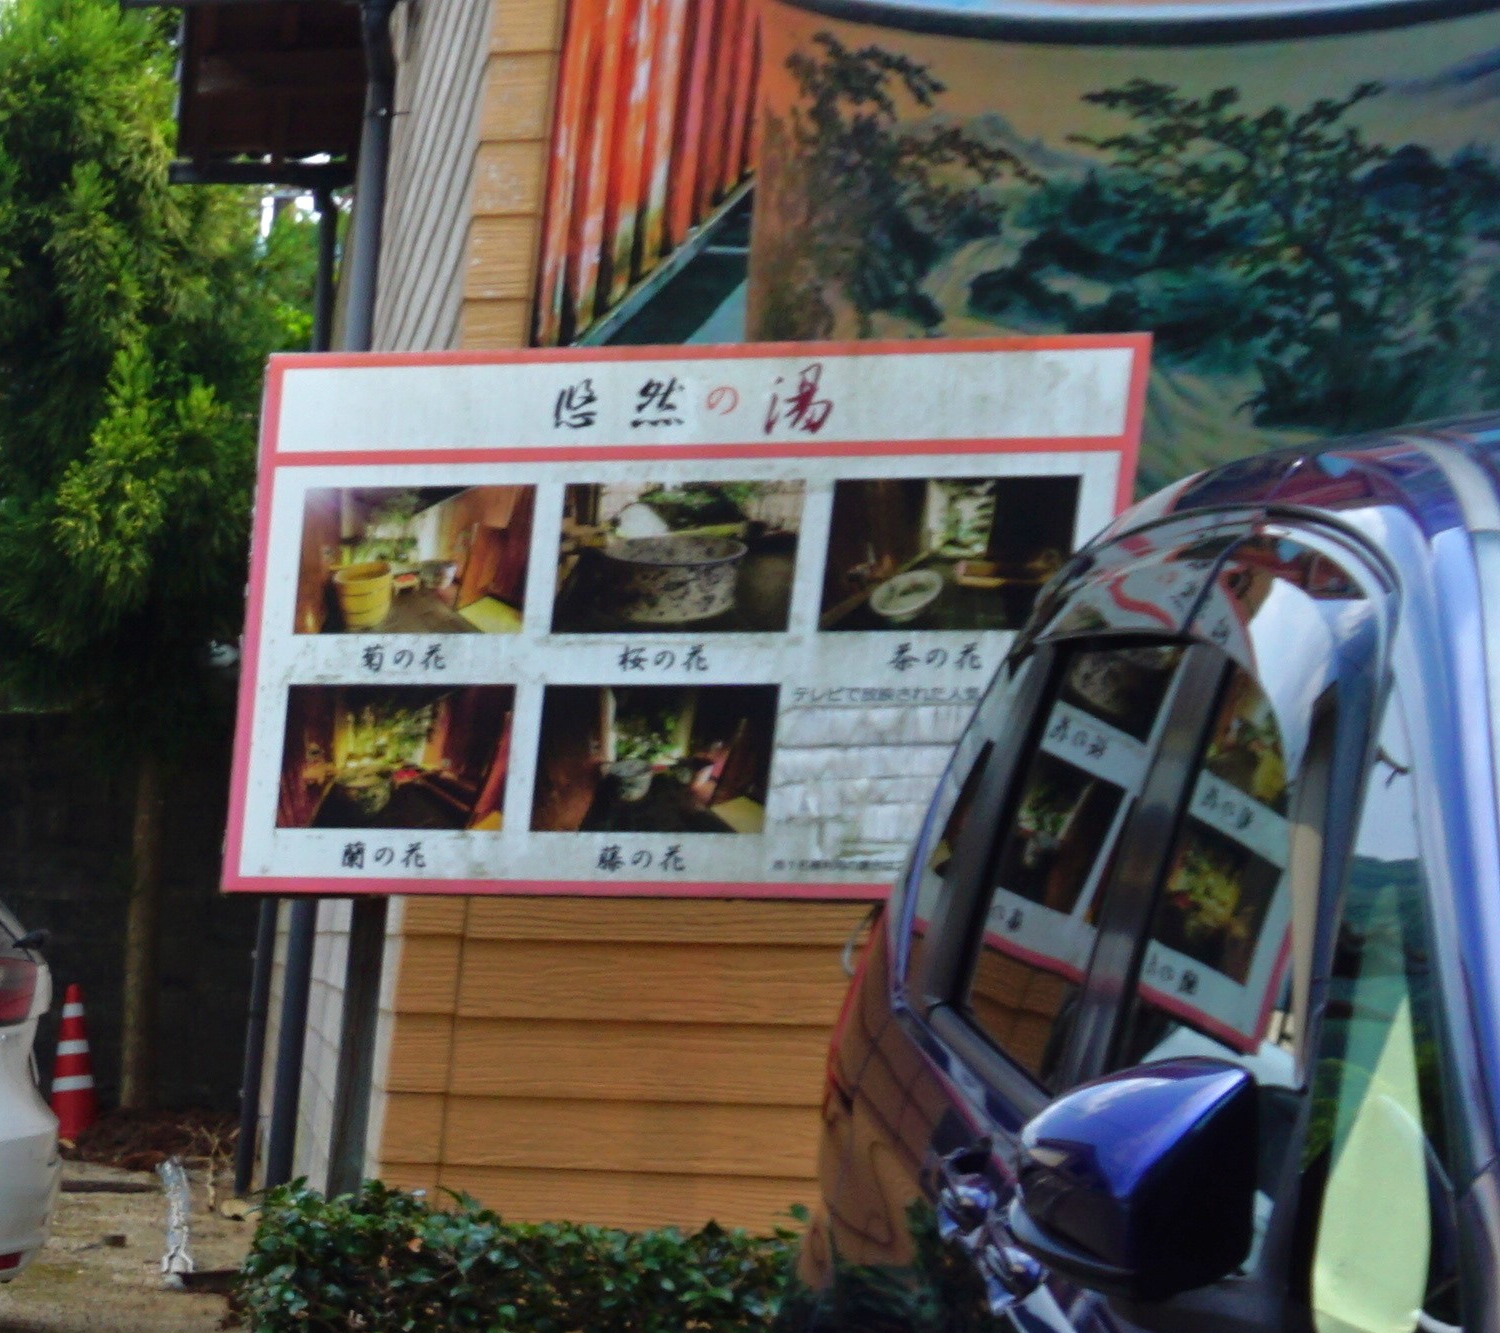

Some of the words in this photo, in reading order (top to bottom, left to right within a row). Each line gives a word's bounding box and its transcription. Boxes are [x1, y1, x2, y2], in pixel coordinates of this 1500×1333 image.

[554, 363, 834, 434] 悠然の湯
[619, 644, 708, 672] 桜の花
